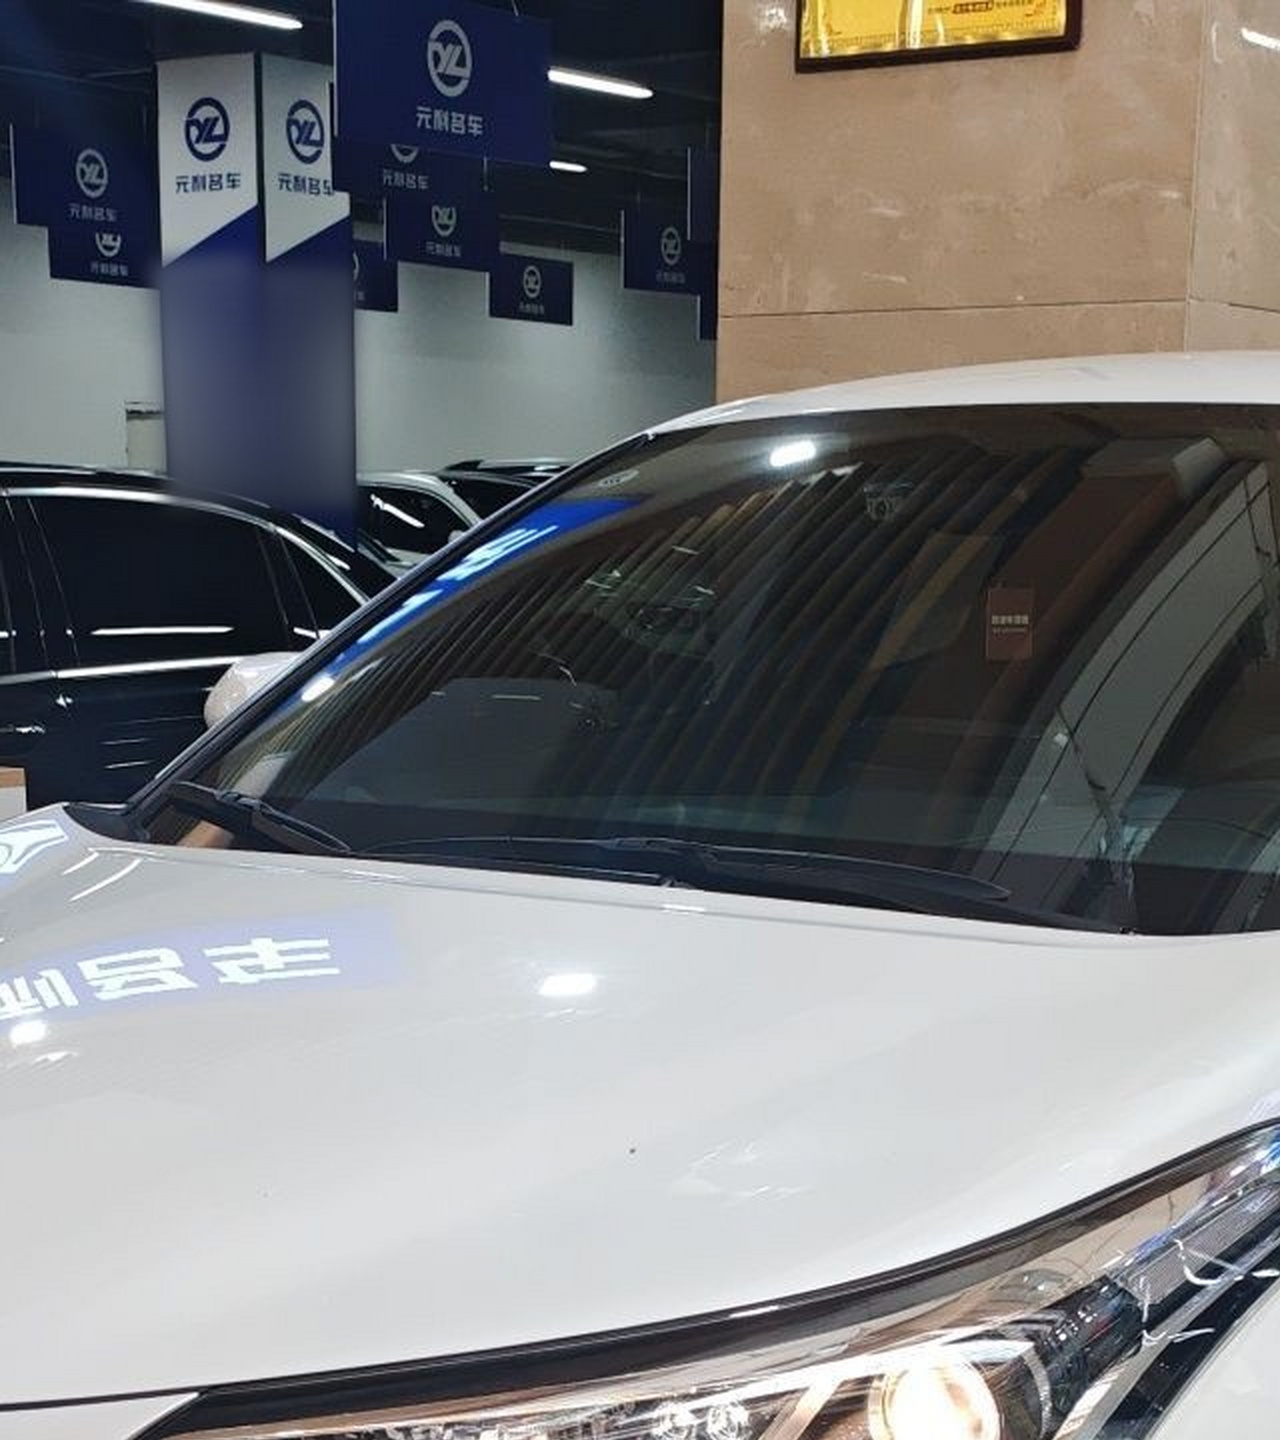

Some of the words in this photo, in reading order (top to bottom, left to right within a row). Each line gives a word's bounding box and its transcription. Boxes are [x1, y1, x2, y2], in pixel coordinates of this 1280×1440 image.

[416, 105, 484, 137] 元利名车
[175, 172, 241, 194] 元利名车
